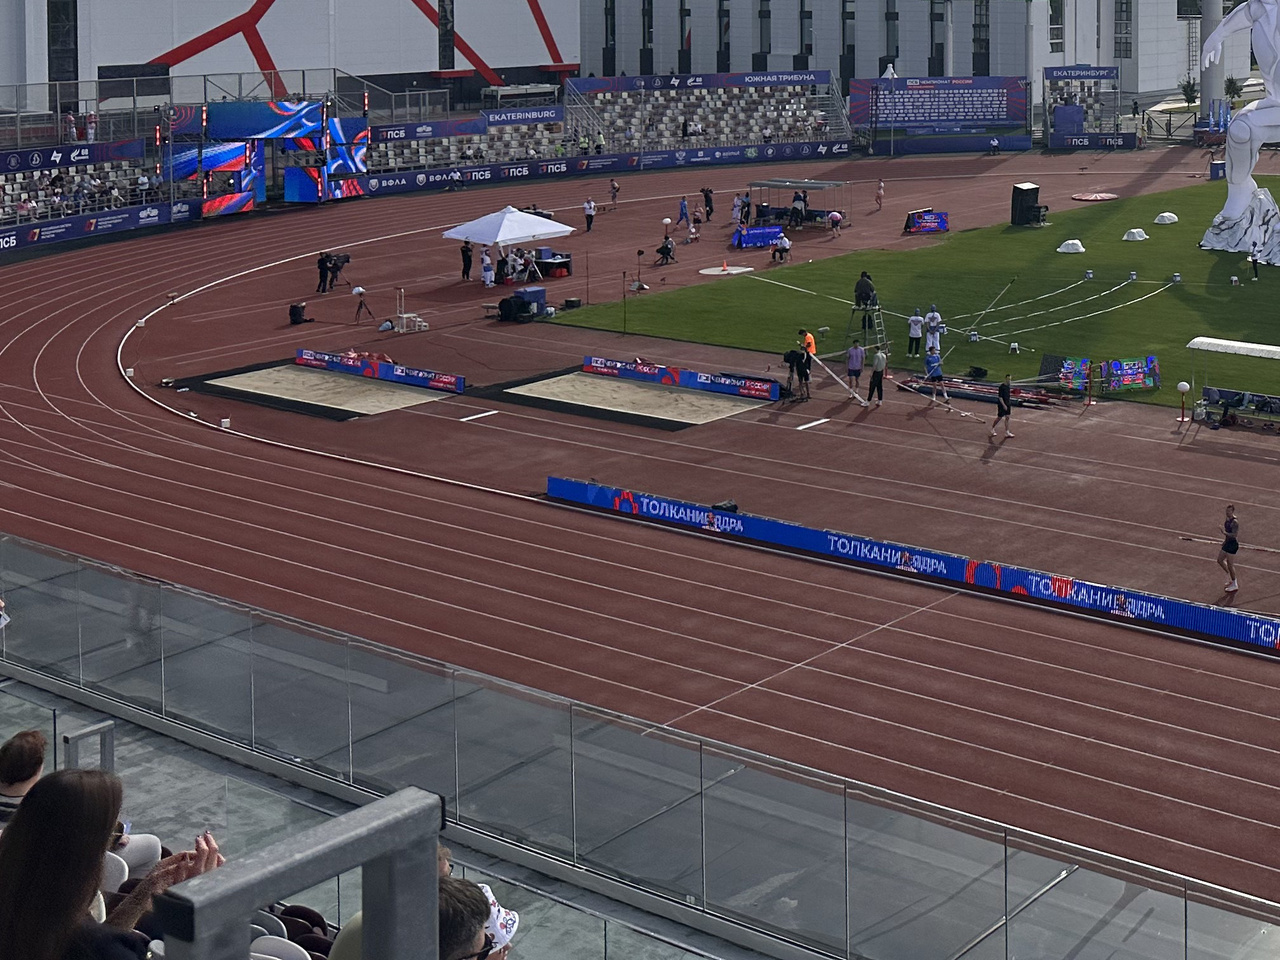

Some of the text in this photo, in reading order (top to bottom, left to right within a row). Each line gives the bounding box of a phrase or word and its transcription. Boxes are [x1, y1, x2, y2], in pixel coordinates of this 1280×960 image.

[745, 74, 815, 83] ЮЖНАЯ ТРИБУНА
[489, 110, 556, 122] EKATERINBURG
[387, 130, 406, 139] ПСБ
[1072, 138, 1089, 146] ПСБ
[1106, 138, 1123, 146] ПСБ
[510, 167, 529, 177] ПСБ
[548, 163, 567, 173] ПСБ
[472, 171, 491, 181] ПСБ
[382, 178, 407, 187] ВФЛА
[641, 498, 744, 532] ТОЛКАНИЕ ЯДРА
